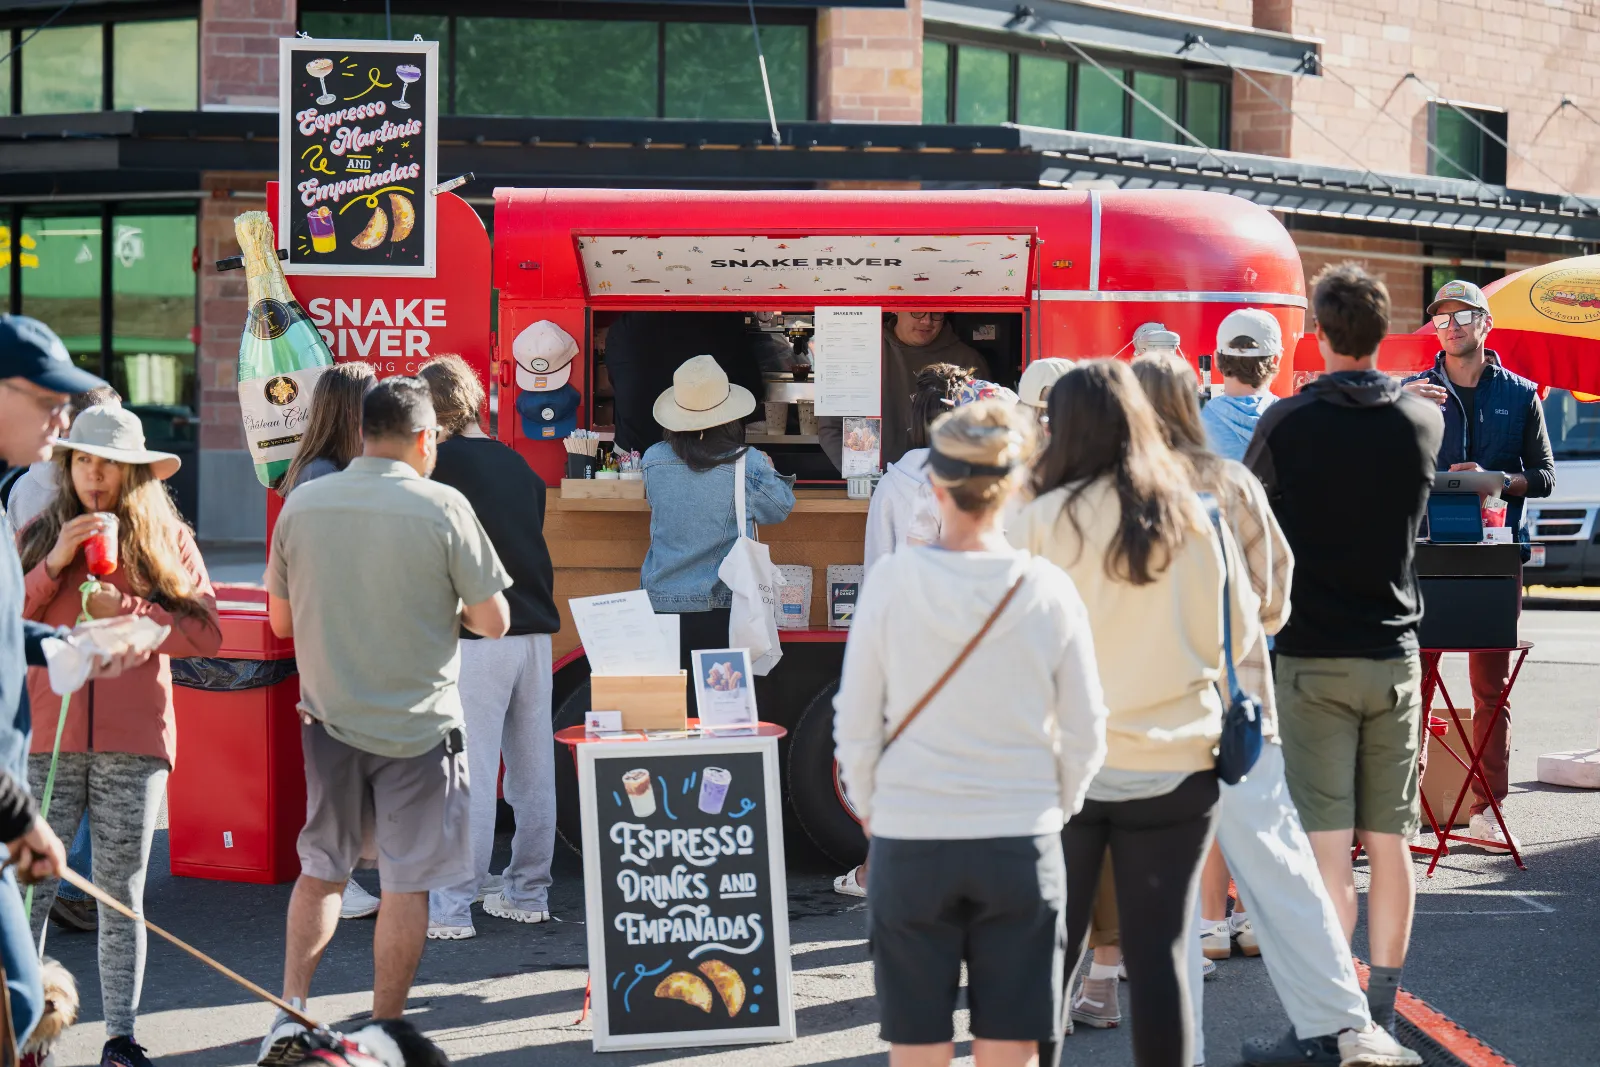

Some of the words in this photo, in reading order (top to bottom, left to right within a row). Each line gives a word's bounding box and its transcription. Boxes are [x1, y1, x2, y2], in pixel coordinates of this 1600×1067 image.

[296, 101, 387, 137] Espresso
[330, 118, 423, 156] Martinis
[346, 159, 371, 170] AND
[298, 162, 421, 207] Empanadas
[711, 258, 809, 268] SNAKE
[816, 257, 903, 267] RIVER
[308, 298, 447, 327] SNAKE
[1540, 306, 1580, 321] Jackson
[321, 329, 431, 357] RIVER
[609, 821, 754, 867] ESPRESSO
[616, 864, 709, 909] DRINKS
[720, 872, 757, 896] AND
[614, 904, 764, 960] EMPANADAS
